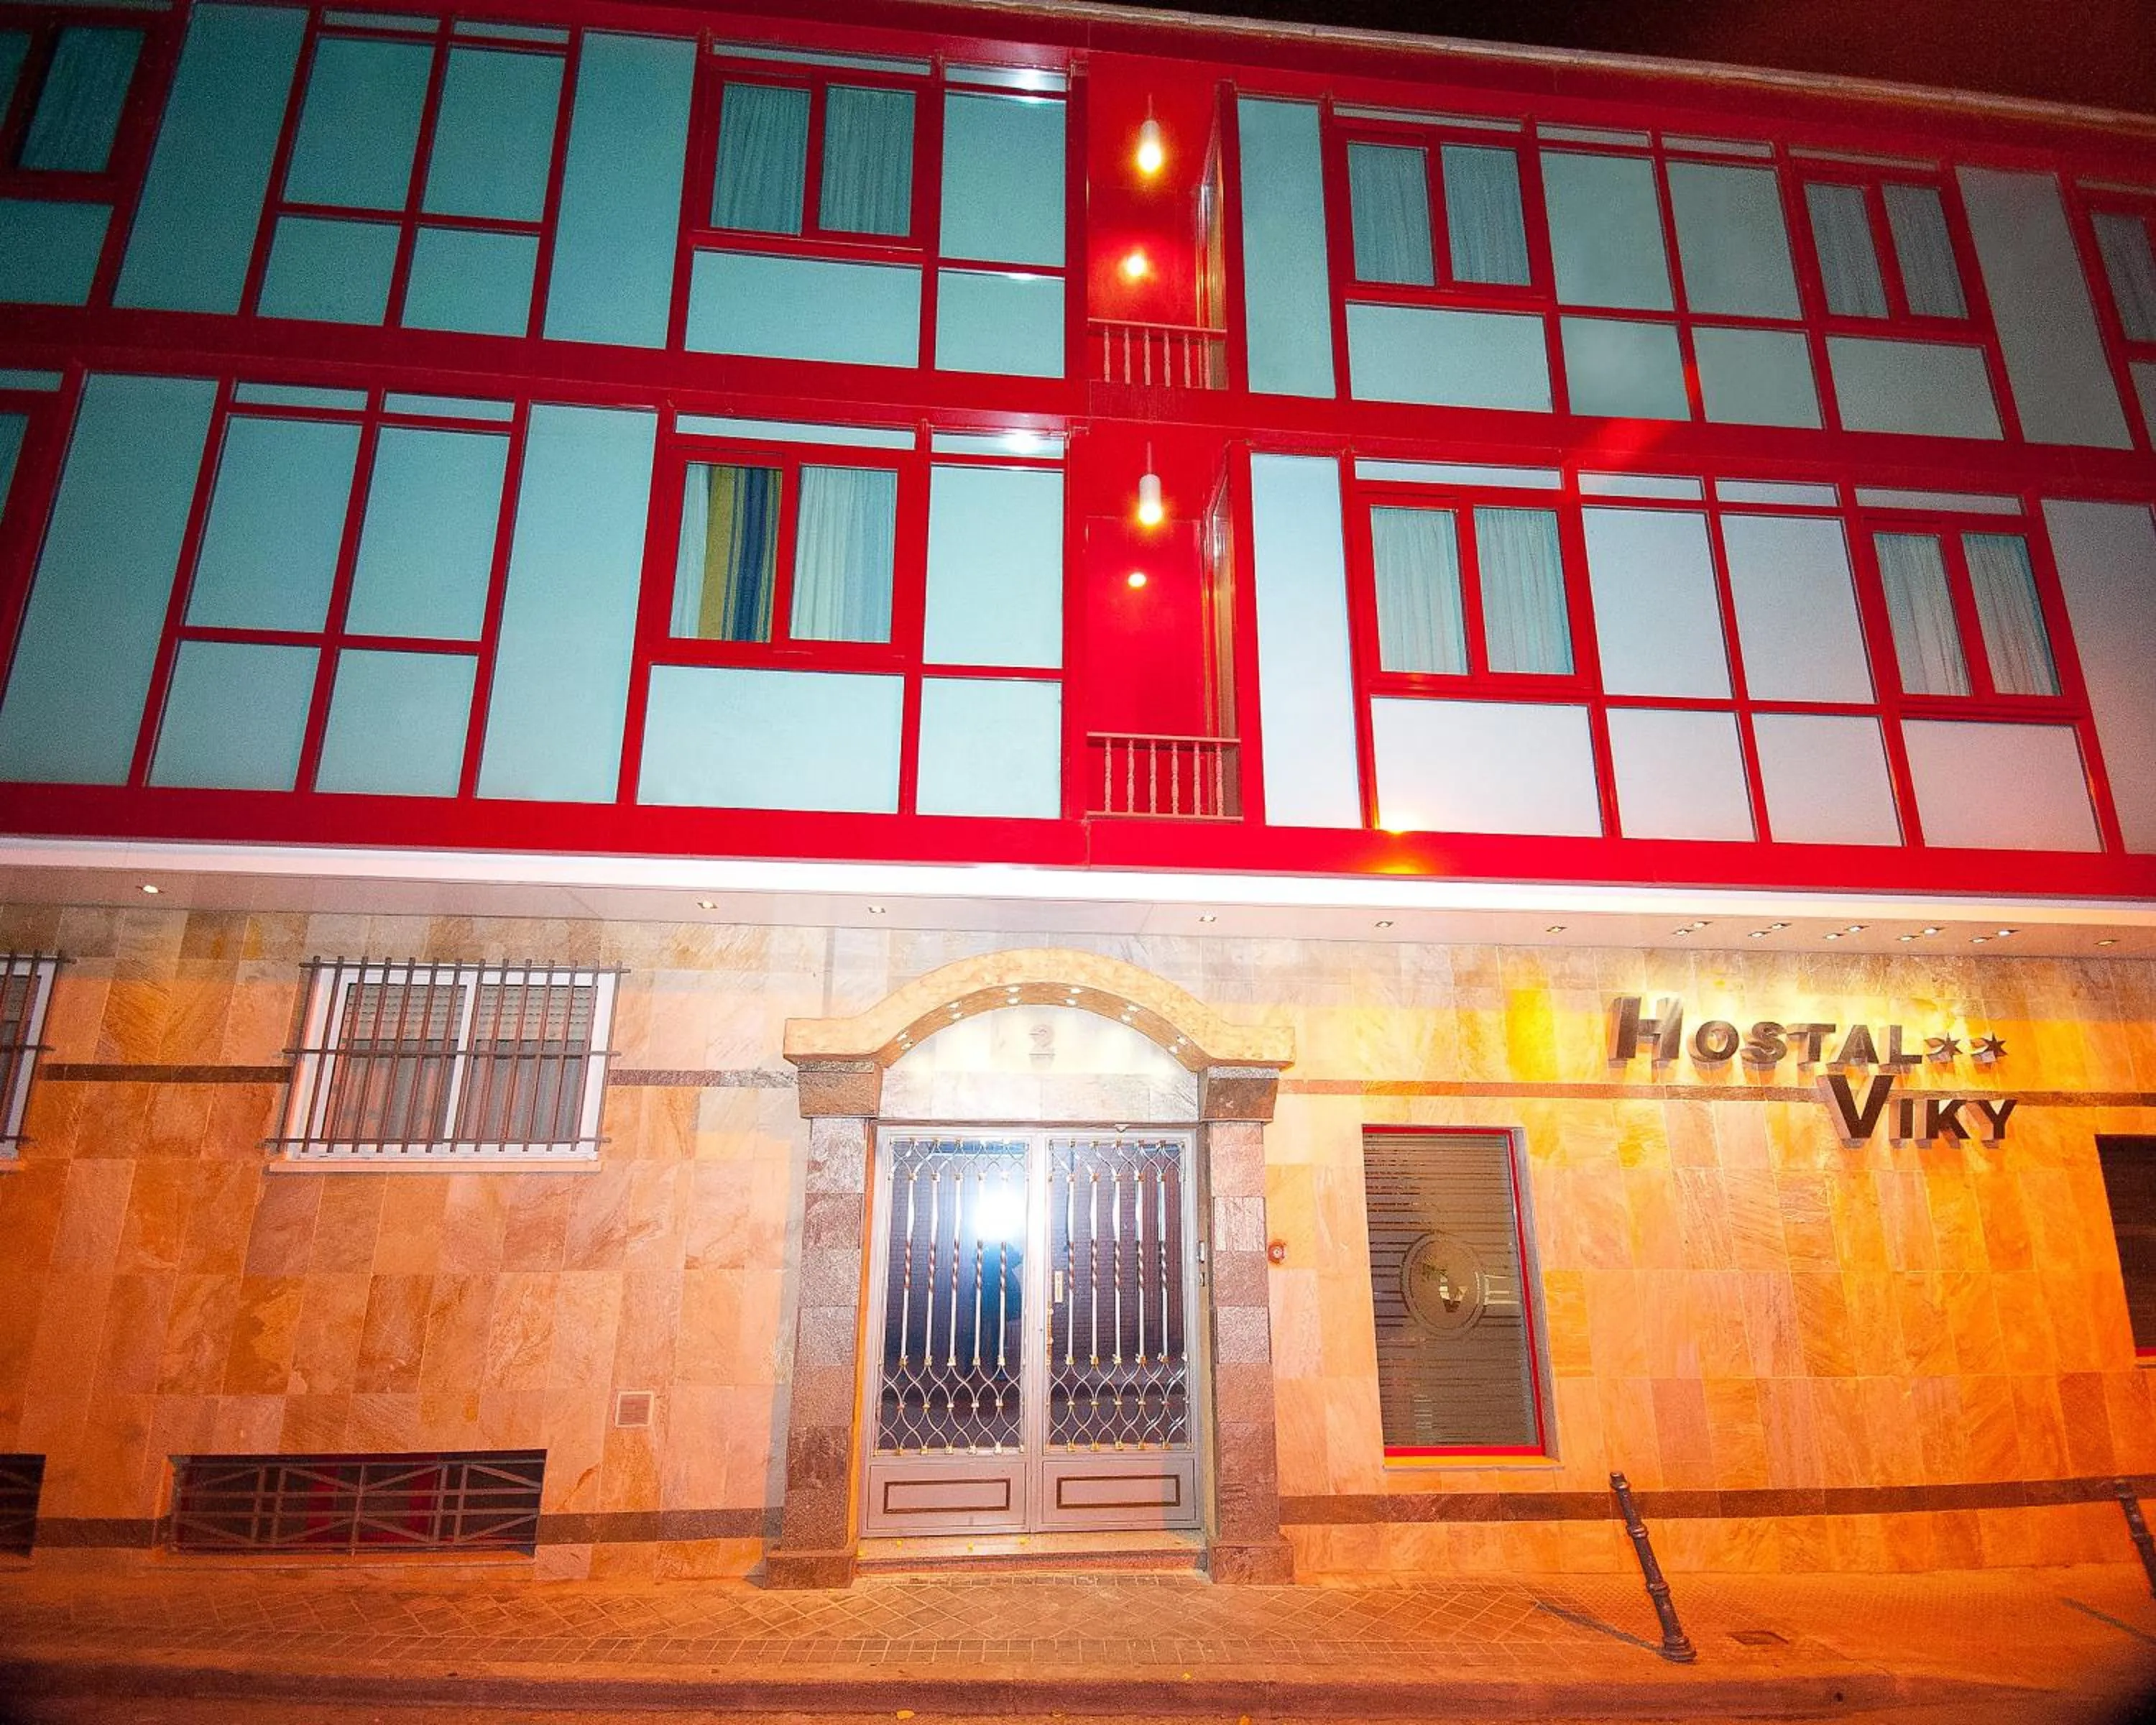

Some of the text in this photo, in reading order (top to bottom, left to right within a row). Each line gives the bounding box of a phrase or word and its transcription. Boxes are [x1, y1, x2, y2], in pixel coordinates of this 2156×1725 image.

[1028, 1024, 1056, 1057] 2
[1609, 997, 1922, 1067] HOSTAL
[1820, 1075, 2017, 1144] VIKY
